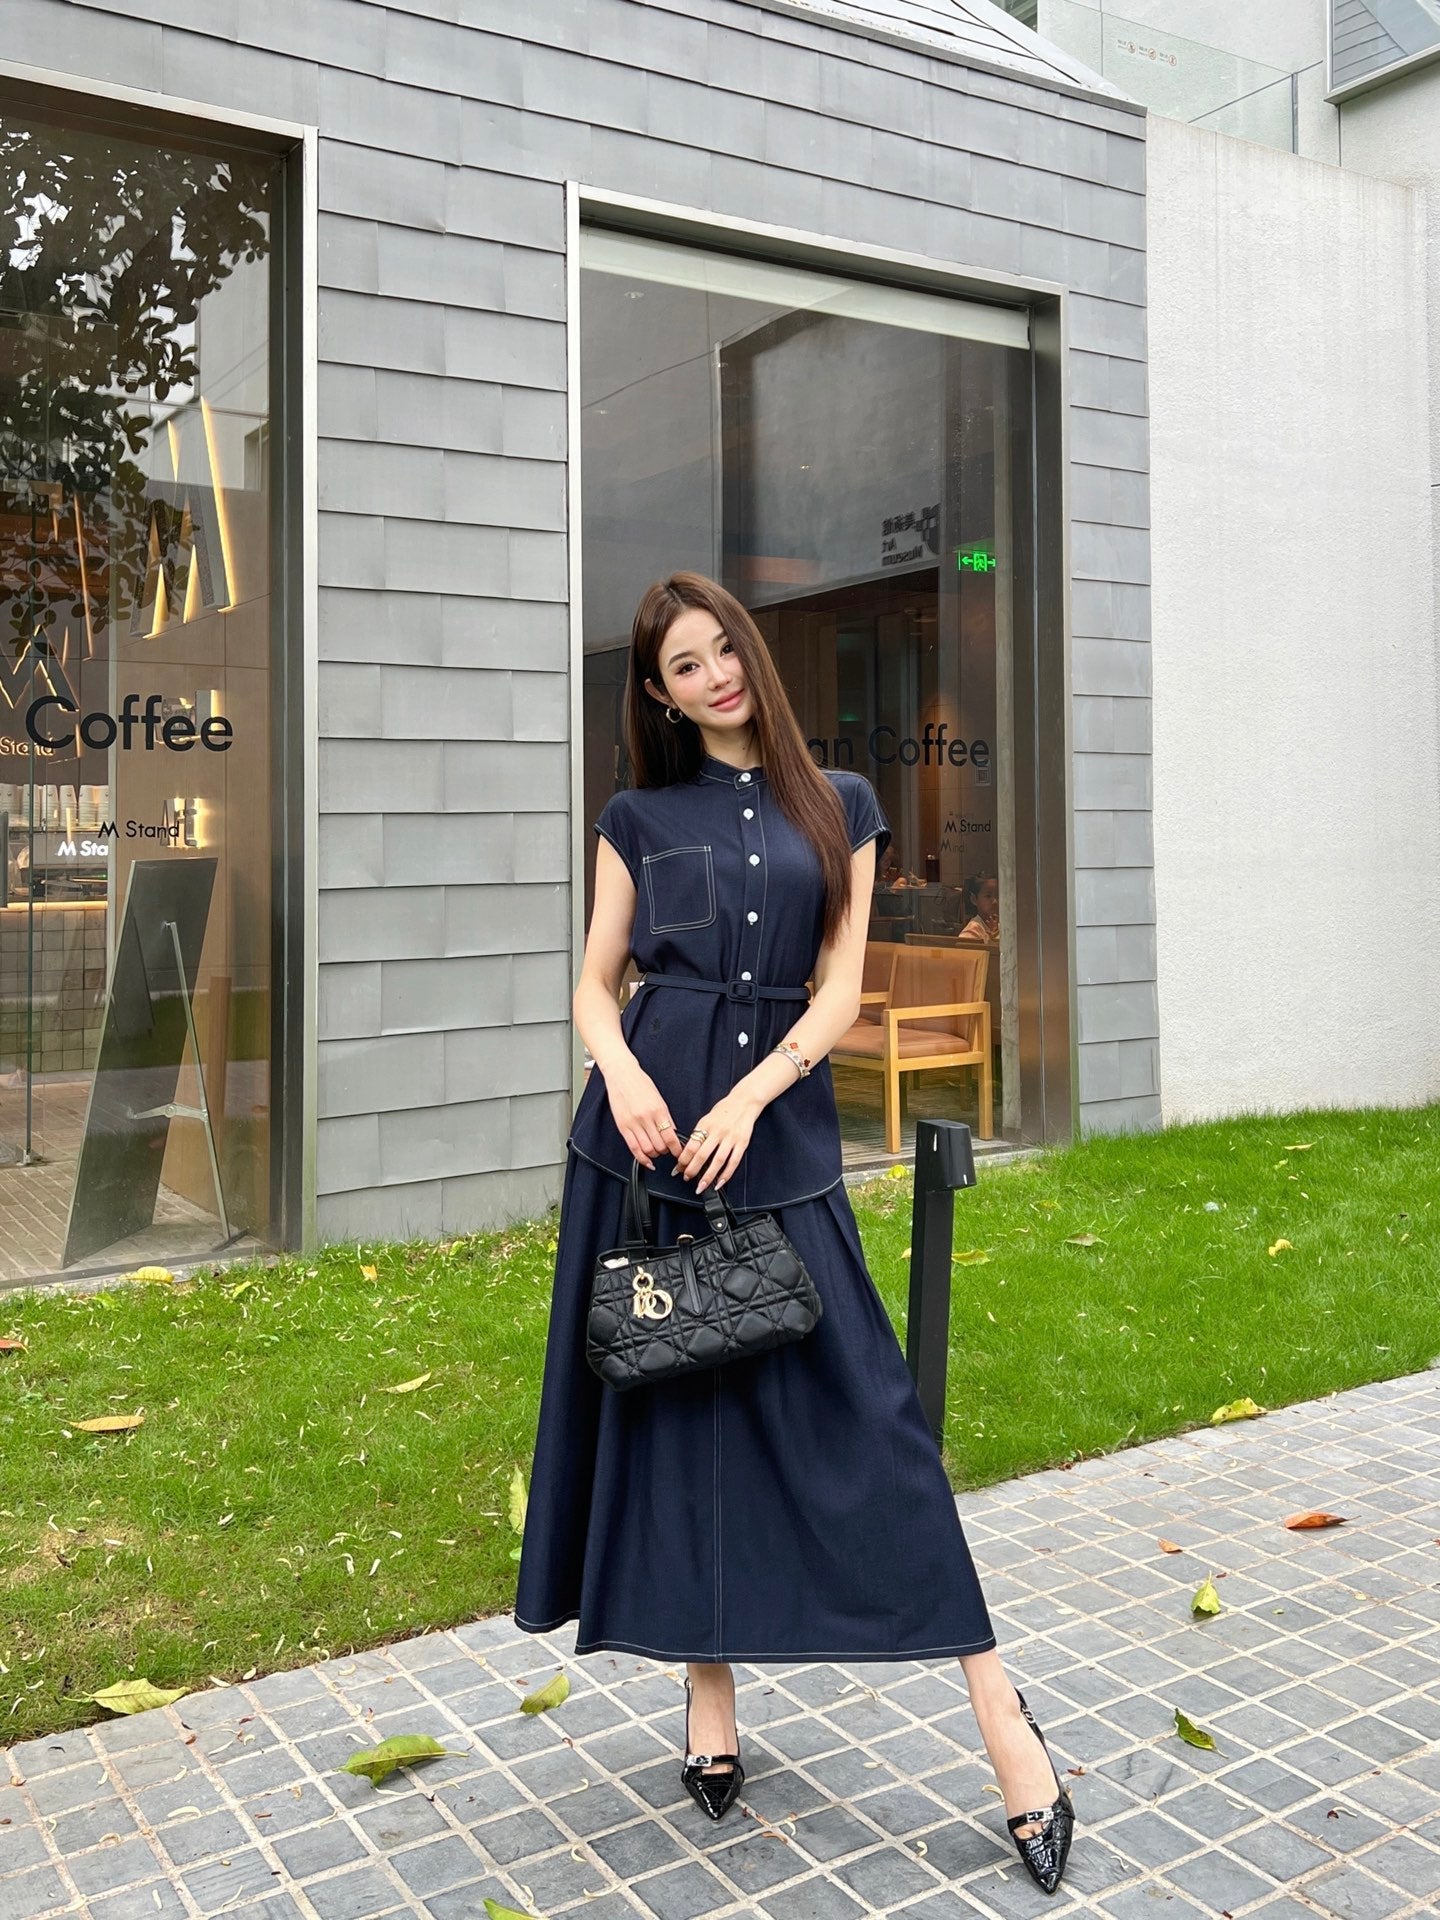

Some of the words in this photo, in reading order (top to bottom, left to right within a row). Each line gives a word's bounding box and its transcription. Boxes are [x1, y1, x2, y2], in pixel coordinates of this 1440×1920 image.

[25, 693, 234, 752] Coffee
[868, 722, 990, 767] Coffee
[97, 821, 120, 839] M
[125, 820, 180, 838] Stand
[944, 820, 957, 833] M
[960, 818, 992, 832] Stand
